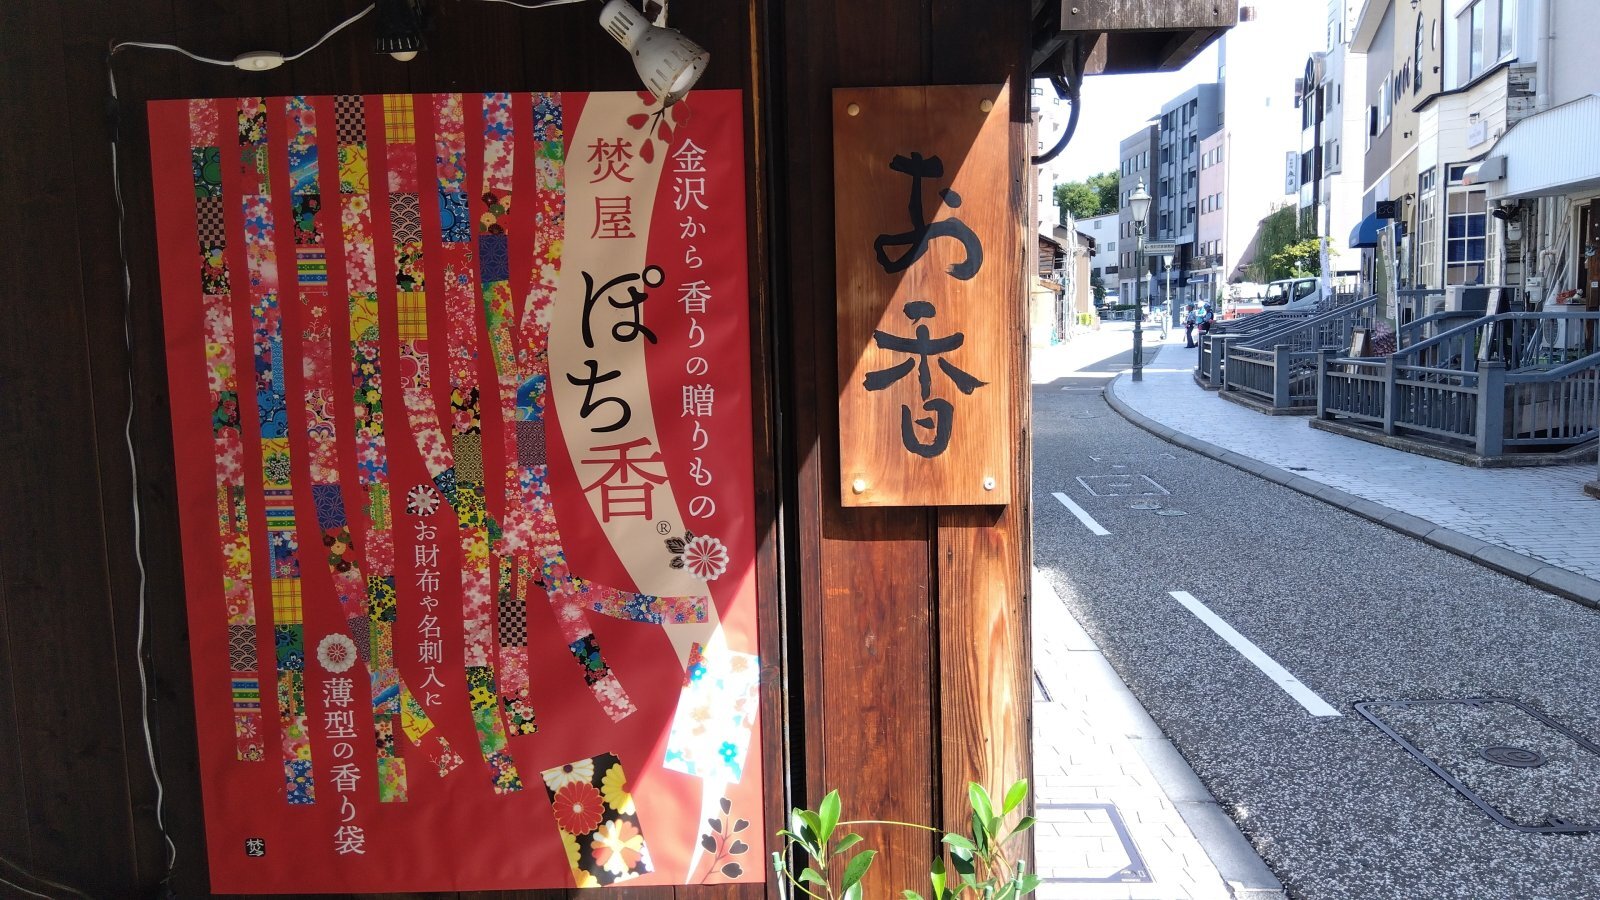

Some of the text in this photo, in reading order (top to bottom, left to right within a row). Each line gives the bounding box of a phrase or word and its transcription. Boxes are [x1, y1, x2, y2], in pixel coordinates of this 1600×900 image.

[566, 137, 668, 523] 焚屋 ぽち香
[672, 138, 716, 519] 金沢から香りの贈りもの
[863, 151, 989, 459] お香
[322, 677, 366, 855] 薄型の香り袋
[414, 520, 445, 707] お財布や名刺入に
